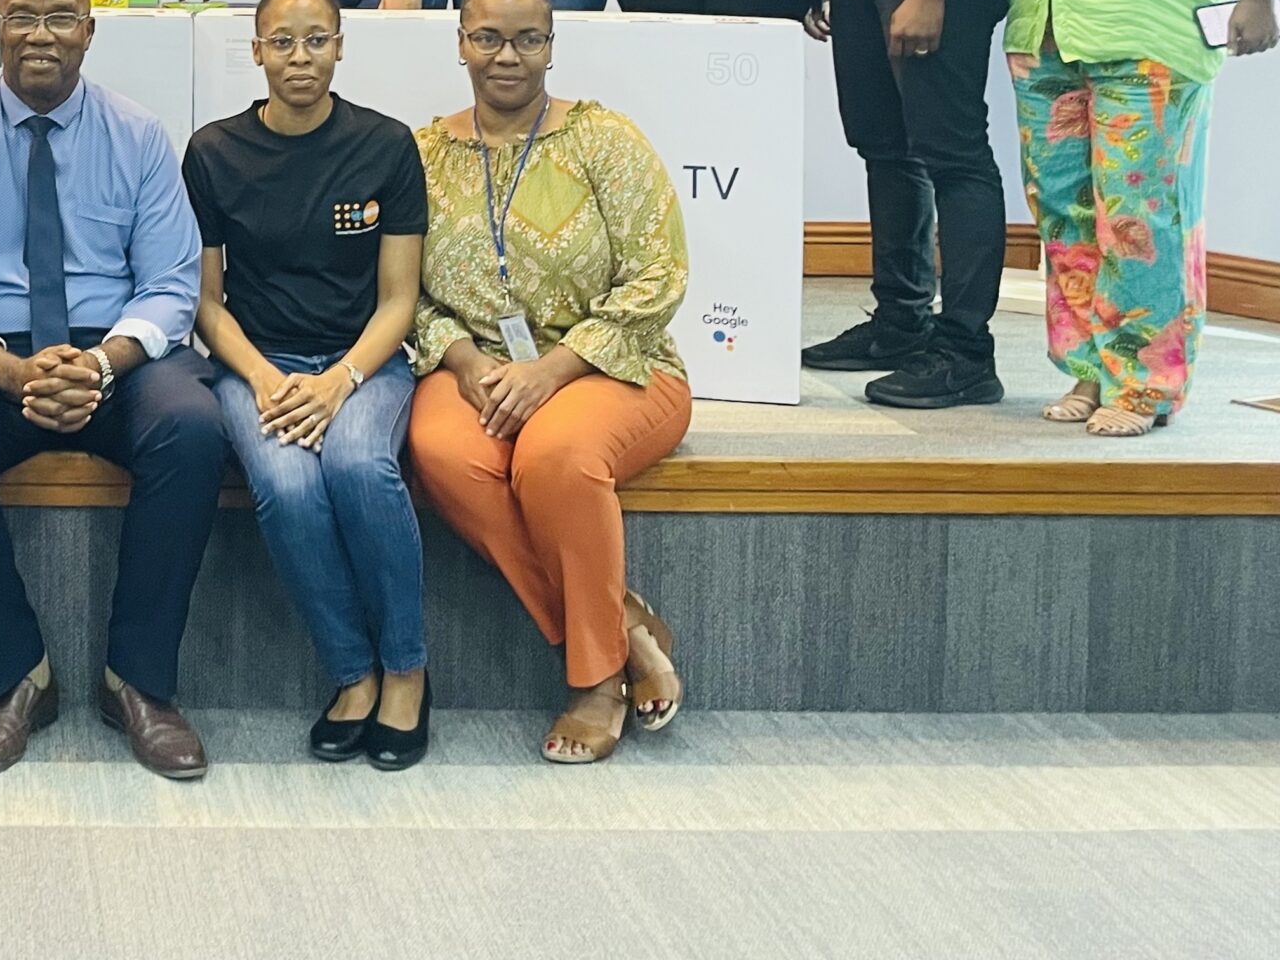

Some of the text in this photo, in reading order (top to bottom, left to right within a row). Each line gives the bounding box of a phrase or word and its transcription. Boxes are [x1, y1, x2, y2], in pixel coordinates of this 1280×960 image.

[706, 52, 759, 86] 50
[683, 165, 740, 200] TV
[713, 302, 738, 316] Hey
[702, 314, 749, 329] Google
